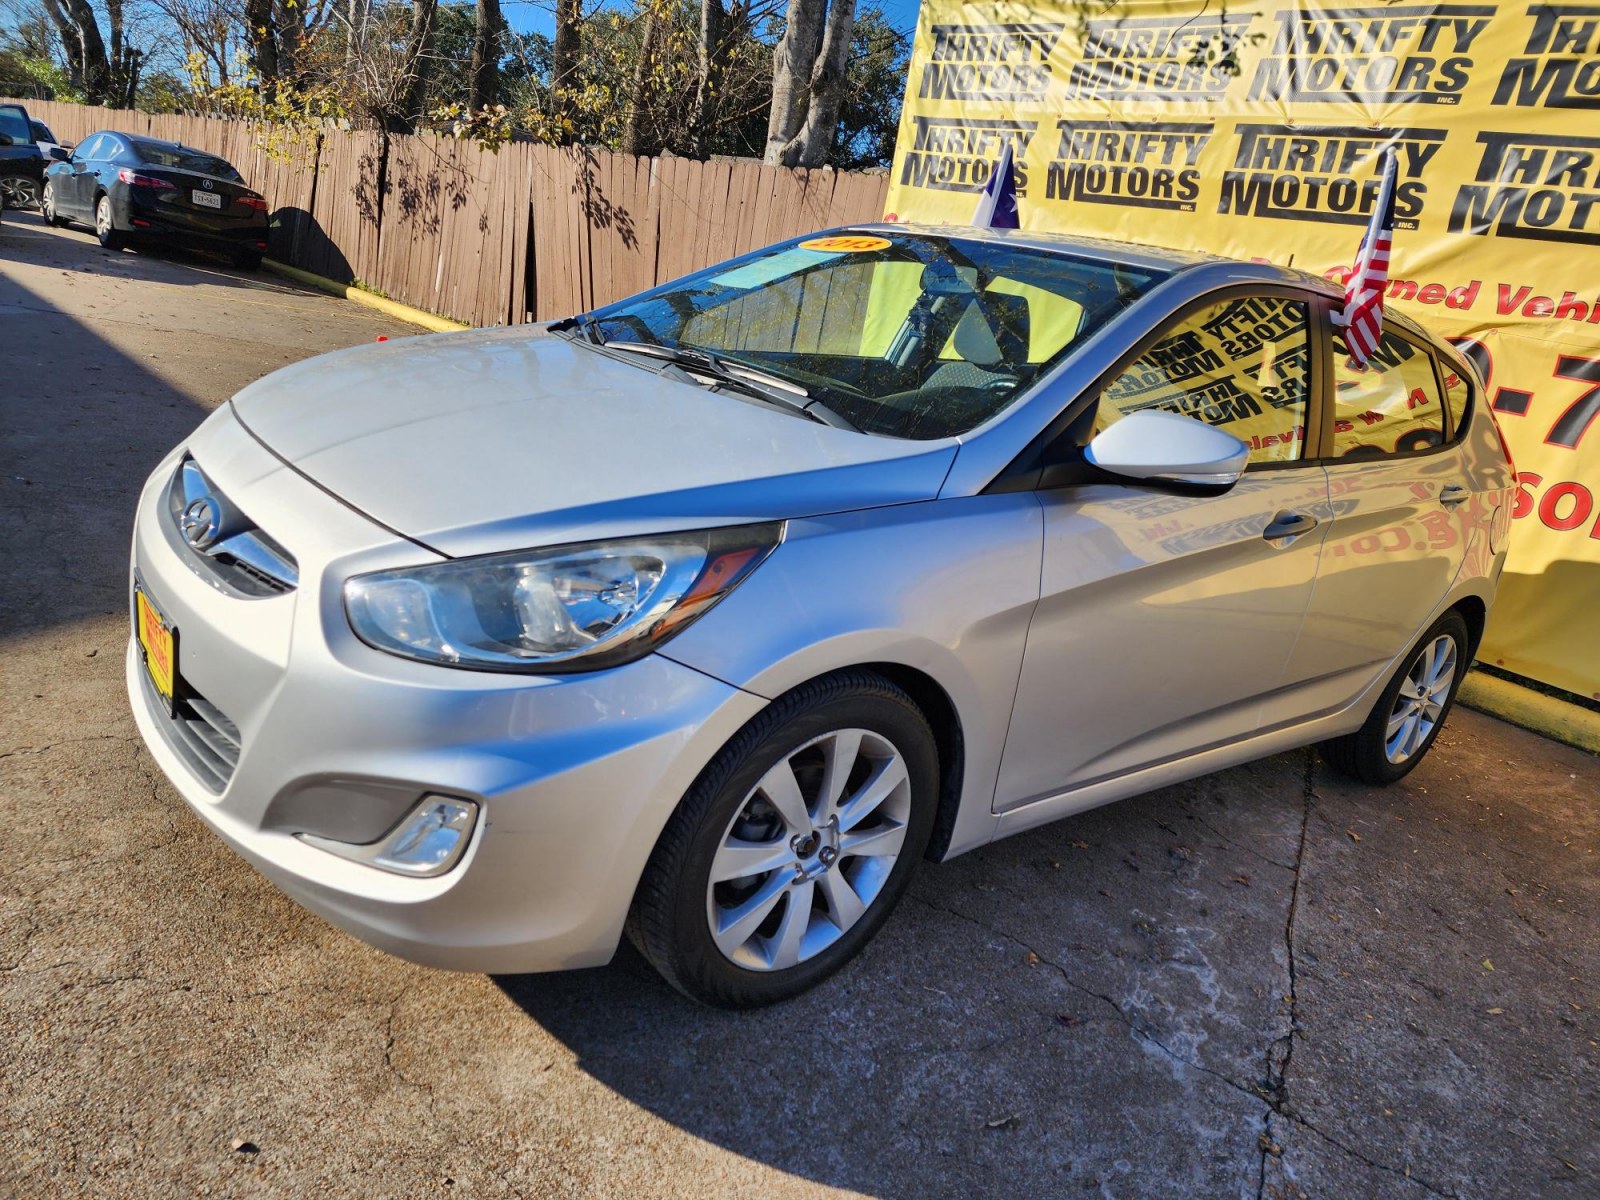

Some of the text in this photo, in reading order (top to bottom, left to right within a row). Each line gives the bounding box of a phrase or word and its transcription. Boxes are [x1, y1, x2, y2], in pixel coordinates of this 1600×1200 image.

[931, 23, 1065, 61] THRIFTY
[1082, 13, 1254, 59] THRIFTY
[1271, 4, 1499, 54] THRIFTY
[1523, 5, 1600, 54] TH
[919, 62, 1052, 101] MOTORS
[1065, 60, 1234, 101] MOTORS
[1245, 55, 1474, 104] MOTORS
[1436, 96, 1457, 104] INC.
[913, 115, 1038, 158] THRIFTY
[1056, 120, 1215, 166] THRIFTY
[1233, 123, 1449, 178] THRIFTY
[1474, 130, 1600, 188] THR
[1045, 161, 1201, 211] MOTORS
[1397, 221, 1415, 229] INC.
